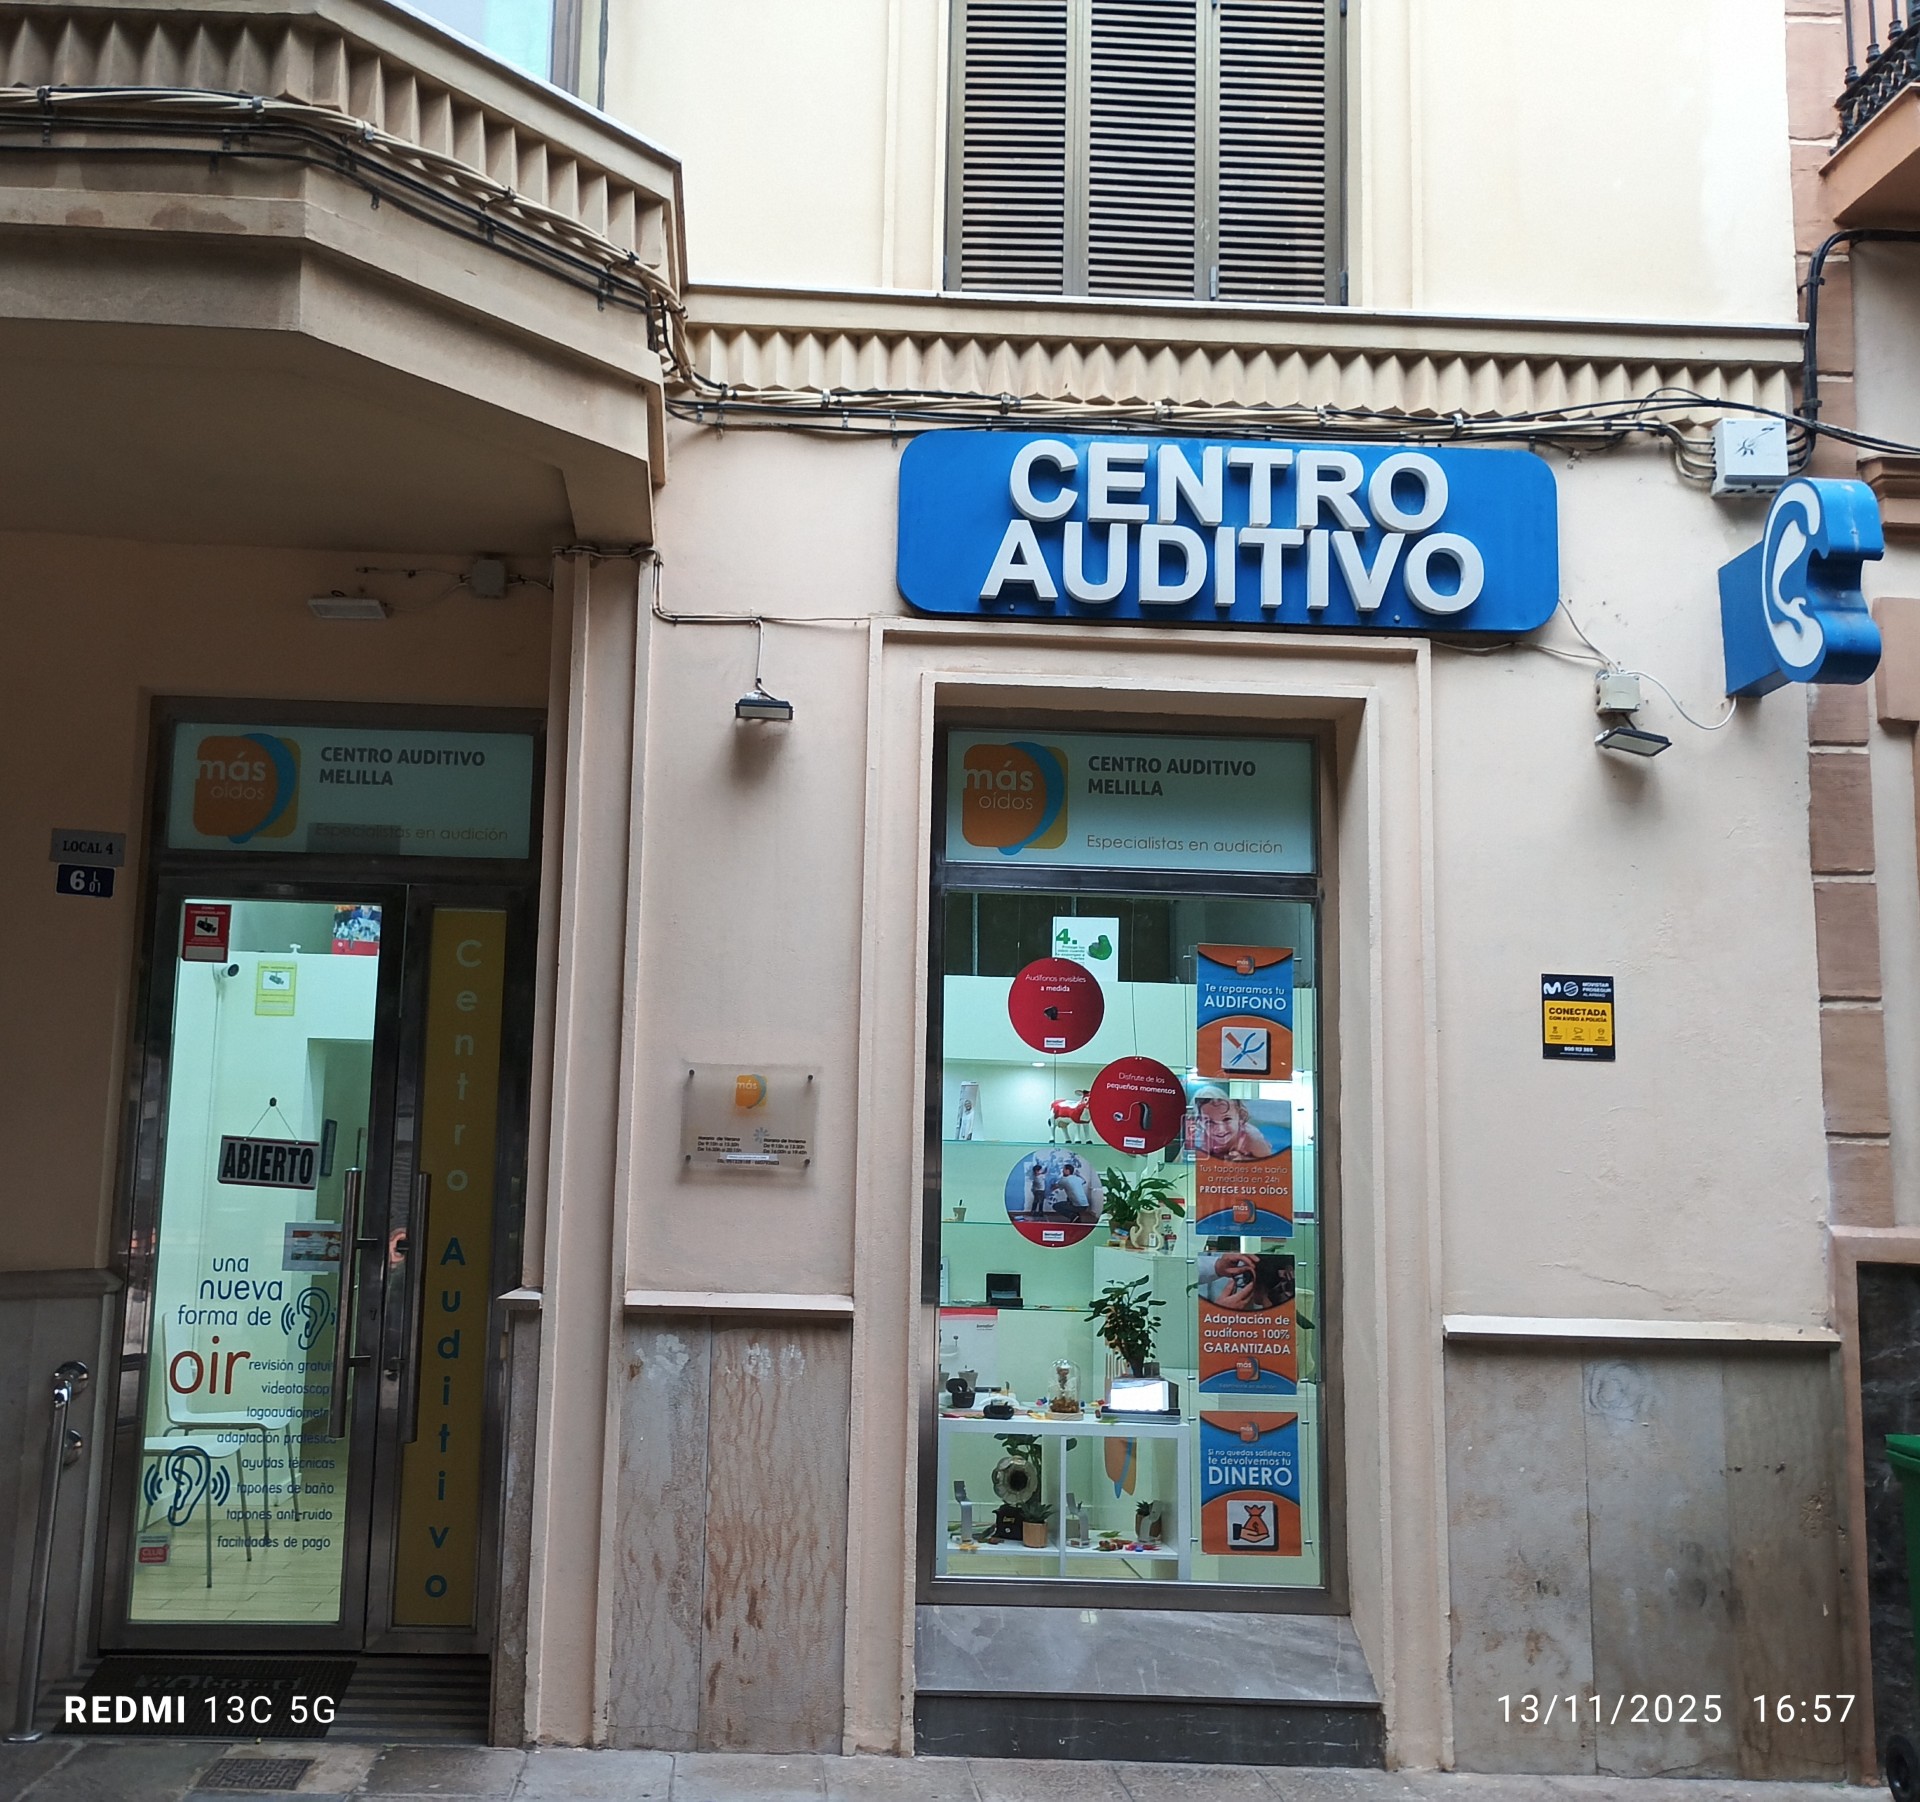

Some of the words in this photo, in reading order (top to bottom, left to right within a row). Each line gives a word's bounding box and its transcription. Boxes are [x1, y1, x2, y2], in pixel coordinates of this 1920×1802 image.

[1009, 439, 1449, 535] CENTRO
[979, 519, 1485, 615] AUDITIVO
[321, 746, 393, 764] CENTRO
[397, 749, 486, 767] AUDITIVO
[198, 752, 266, 782] más
[1087, 755, 1162, 774] CENTRO
[1166, 758, 1257, 777] AUDITIVO
[319, 768, 394, 786] MELILLA
[963, 760, 1034, 792] más
[209, 783, 265, 801] oídos
[1087, 777, 1164, 798] MELILLA
[978, 792, 1034, 811] oídos
[314, 823, 412, 840] Especialistas
[415, 829, 436, 840] en
[439, 827, 509, 842] audición
[63, 840, 103, 854] LOCAL
[105, 842, 114, 855] 4
[1086, 833, 1185, 852] Especialistas
[1189, 840, 1210, 853] en
[1213, 838, 1284, 855] audición
[70, 869, 86, 891] 6
[1056, 928, 1078, 945] 4.
[1205, 983, 1217, 992] Te
[1219, 985, 1273, 995] reparamos
[1275, 986, 1285, 995] tu
[1203, 994, 1287, 1011] AUDIFONO
[1549, 1007, 1607, 1016] CONECTADA
[446, 938, 484, 1192] Centro
[1118, 1072, 1145, 1082] Disfrute
[1145, 1075, 1155, 1083] de
[1155, 1076, 1165, 1084] los
[1106, 1082, 1138, 1091] pequeños
[1140, 1086, 1176, 1095] momentos
[221, 1141, 314, 1185] ABIERTO
[1214, 1165, 1249, 1175] tapones
[1251, 1165, 1263, 1173] de
[1215, 1175, 1249, 1183] medida
[1199, 1185, 1239, 1194] PROTEGE
[1241, 1186, 1257, 1194] SUS
[1259, 1184, 1289, 1195] OÍDOS
[1232, 1202, 1248, 1211] más
[213, 1257, 249, 1272] una
[200, 1279, 283, 1301] nueva
[178, 1304, 238, 1325] forma
[247, 1306, 272, 1326] de
[1203, 1313, 1272, 1326] Adaptación
[1274, 1315, 1290, 1325] de
[1204, 1327, 1259, 1338] audífonos
[1262, 1329, 1290, 1339] 100%
[1203, 1342, 1291, 1354] GARANTIZADA
[169, 1335, 251, 1395] oir
[248, 1360, 294, 1371] revisión
[297, 1360, 332, 1374] gratui
[1236, 1360, 1252, 1368] más
[261, 1380, 330, 1397] videotoscop
[246, 1406, 329, 1421] logoaudiometr
[424, 1237, 467, 1598] Auditivo
[216, 1432, 280, 1446] adaptación
[1207, 1448, 1214, 1456] Si
[1226, 1450, 1254, 1458] quedas
[1208, 1456, 1218, 1465] te
[1220, 1456, 1280, 1466] devolvemos
[1282, 1457, 1292, 1466] tu
[241, 1457, 284, 1471] ayudas
[288, 1457, 336, 1469] técnicas
[1208, 1466, 1293, 1486] DINERO
[236, 1484, 283, 1496] tapones
[286, 1483, 301, 1494] de
[304, 1482, 335, 1494] baño
[226, 1509, 273, 1522] tapones
[276, 1508, 333, 1520] anti-ruido
[216, 1535, 280, 1548] facilidades
[283, 1536, 298, 1548] de
[302, 1539, 331, 1551] pago
